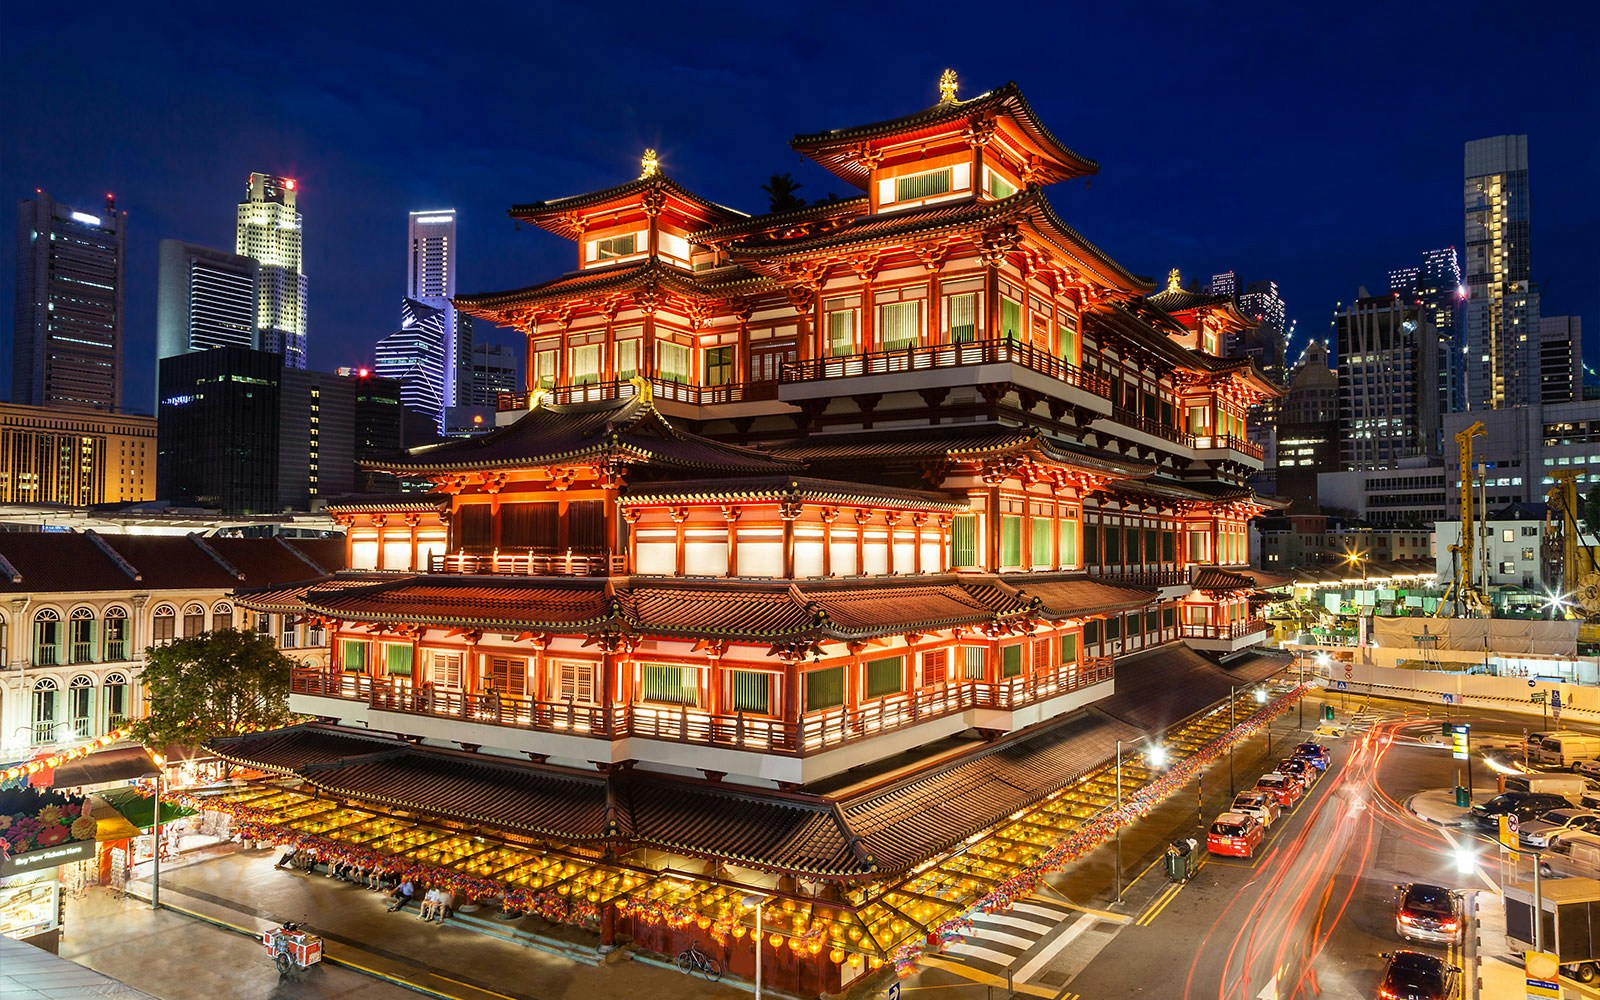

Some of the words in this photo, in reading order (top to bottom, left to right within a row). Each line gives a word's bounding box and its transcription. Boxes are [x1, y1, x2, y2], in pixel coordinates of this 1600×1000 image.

[15, 858, 29, 866] Buy
[43, 850, 66, 859] Tickets
[66, 846, 82, 855] Here
